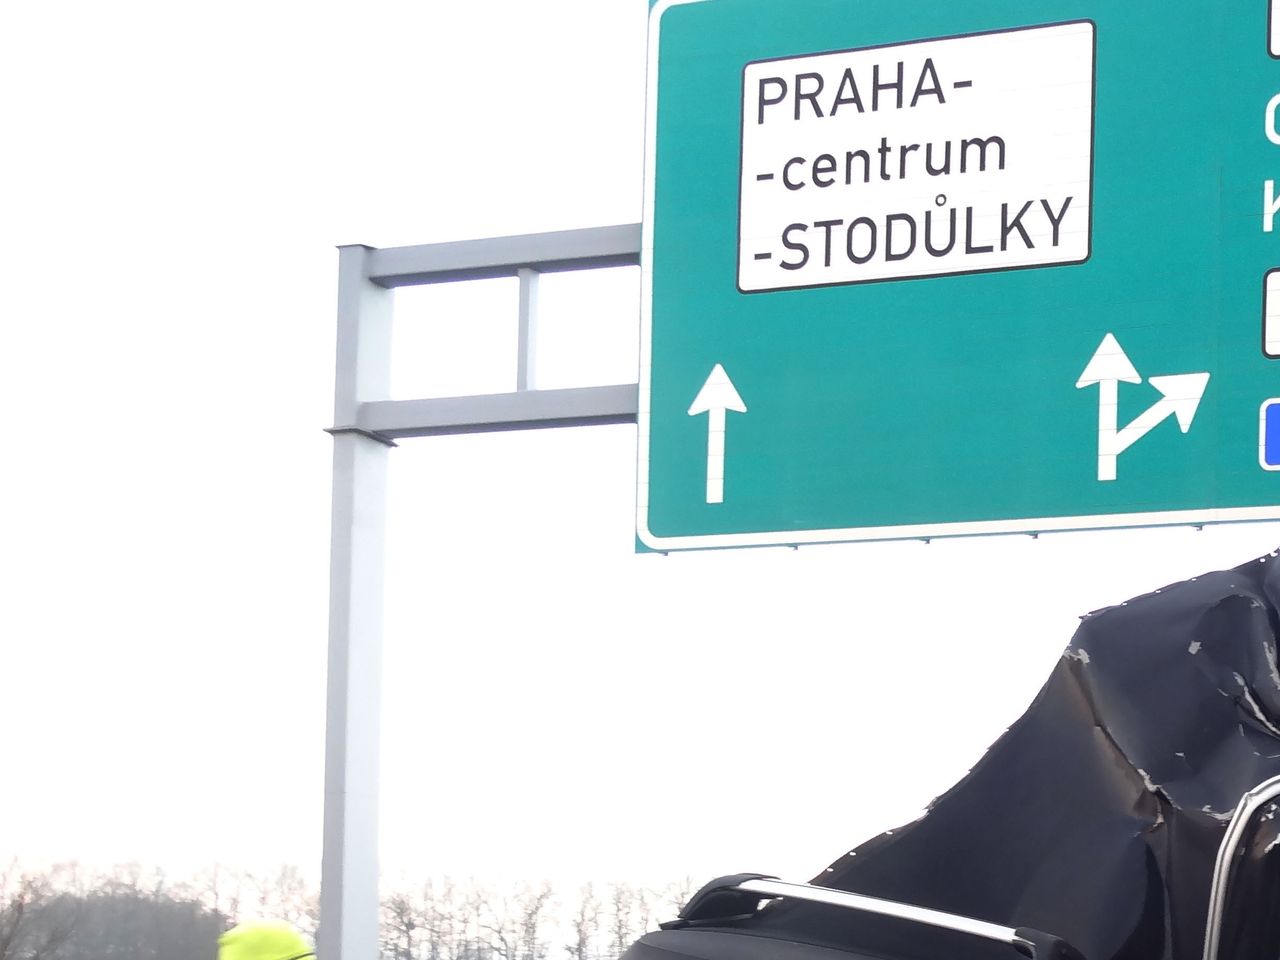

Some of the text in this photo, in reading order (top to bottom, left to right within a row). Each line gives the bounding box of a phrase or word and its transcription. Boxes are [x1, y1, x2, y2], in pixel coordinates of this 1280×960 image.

[757, 57, 973, 125] PRAHA-
[756, 135, 1006, 191] -centrum
[754, 193, 1073, 271] -STODŮLKY
